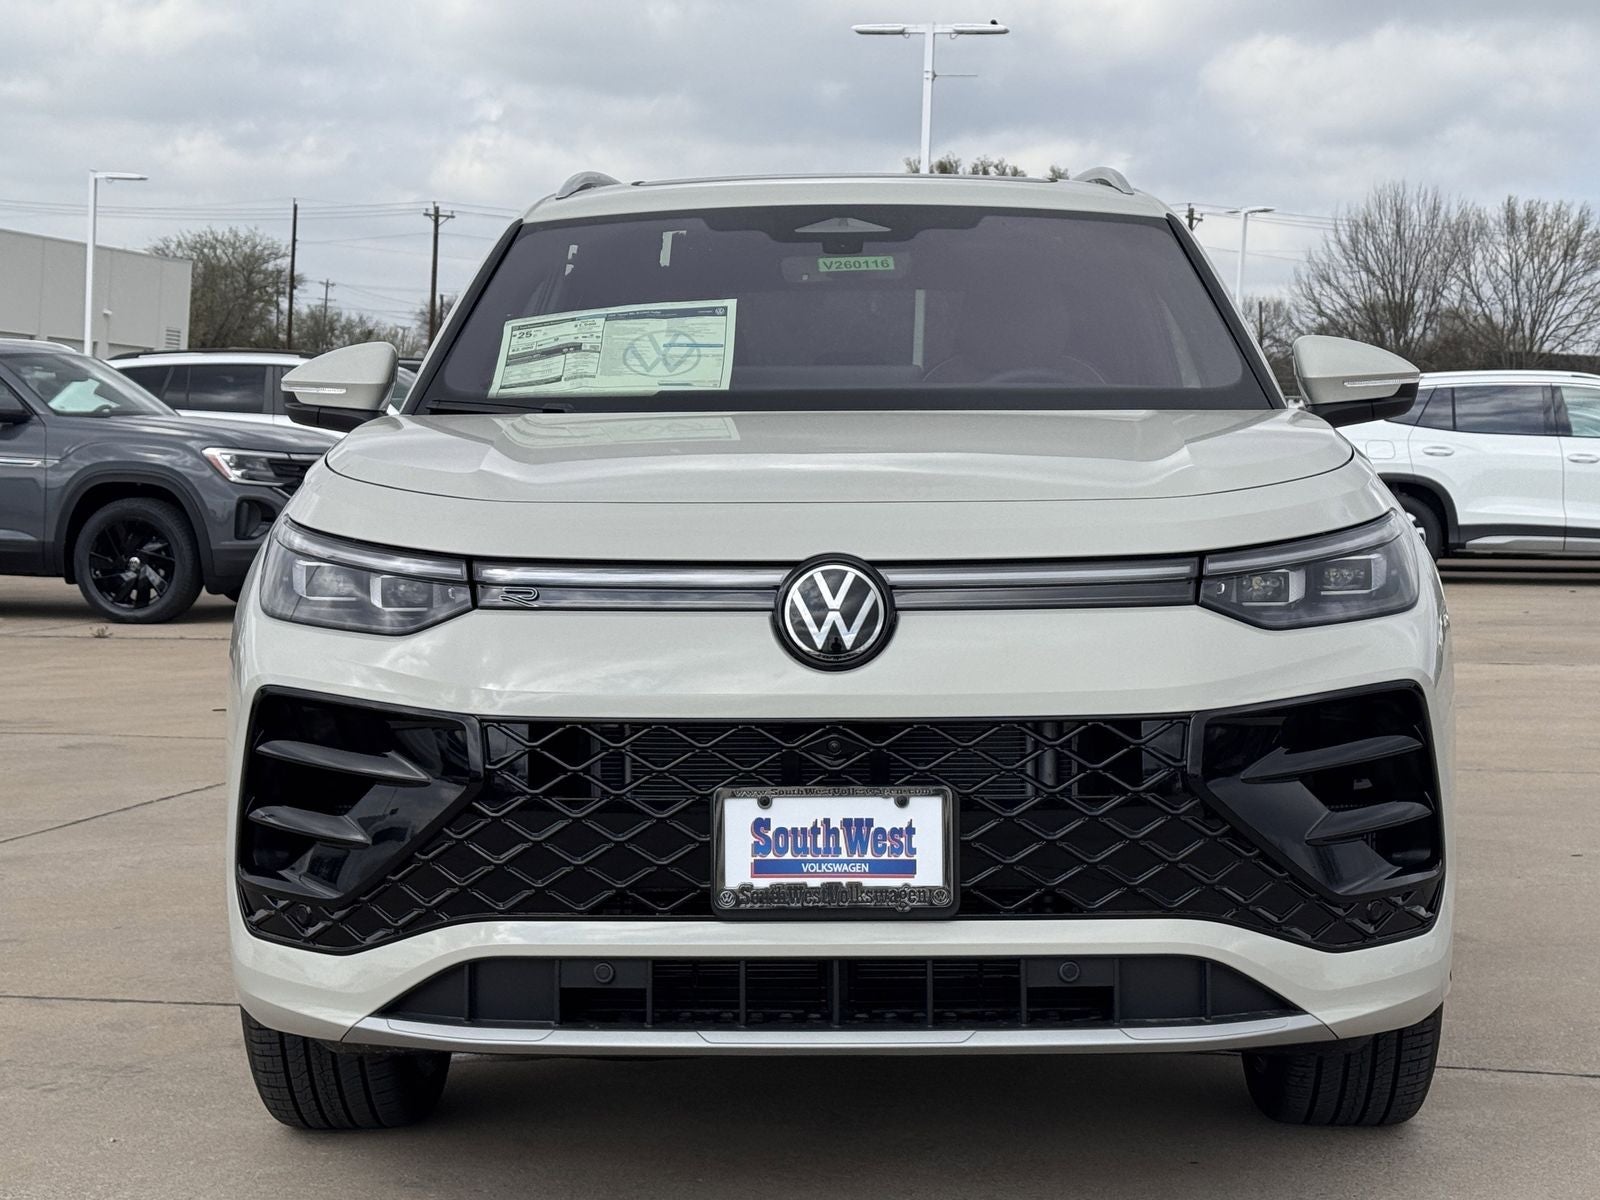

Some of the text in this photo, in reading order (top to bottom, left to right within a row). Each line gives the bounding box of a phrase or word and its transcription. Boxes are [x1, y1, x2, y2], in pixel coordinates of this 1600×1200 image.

[822, 258, 891, 271] V260116
[517, 330, 533, 339] 25
[784, 564, 885, 658] VW
[751, 817, 917, 858] SouthWest
[801, 862, 869, 873] VOLKSWAGEN
